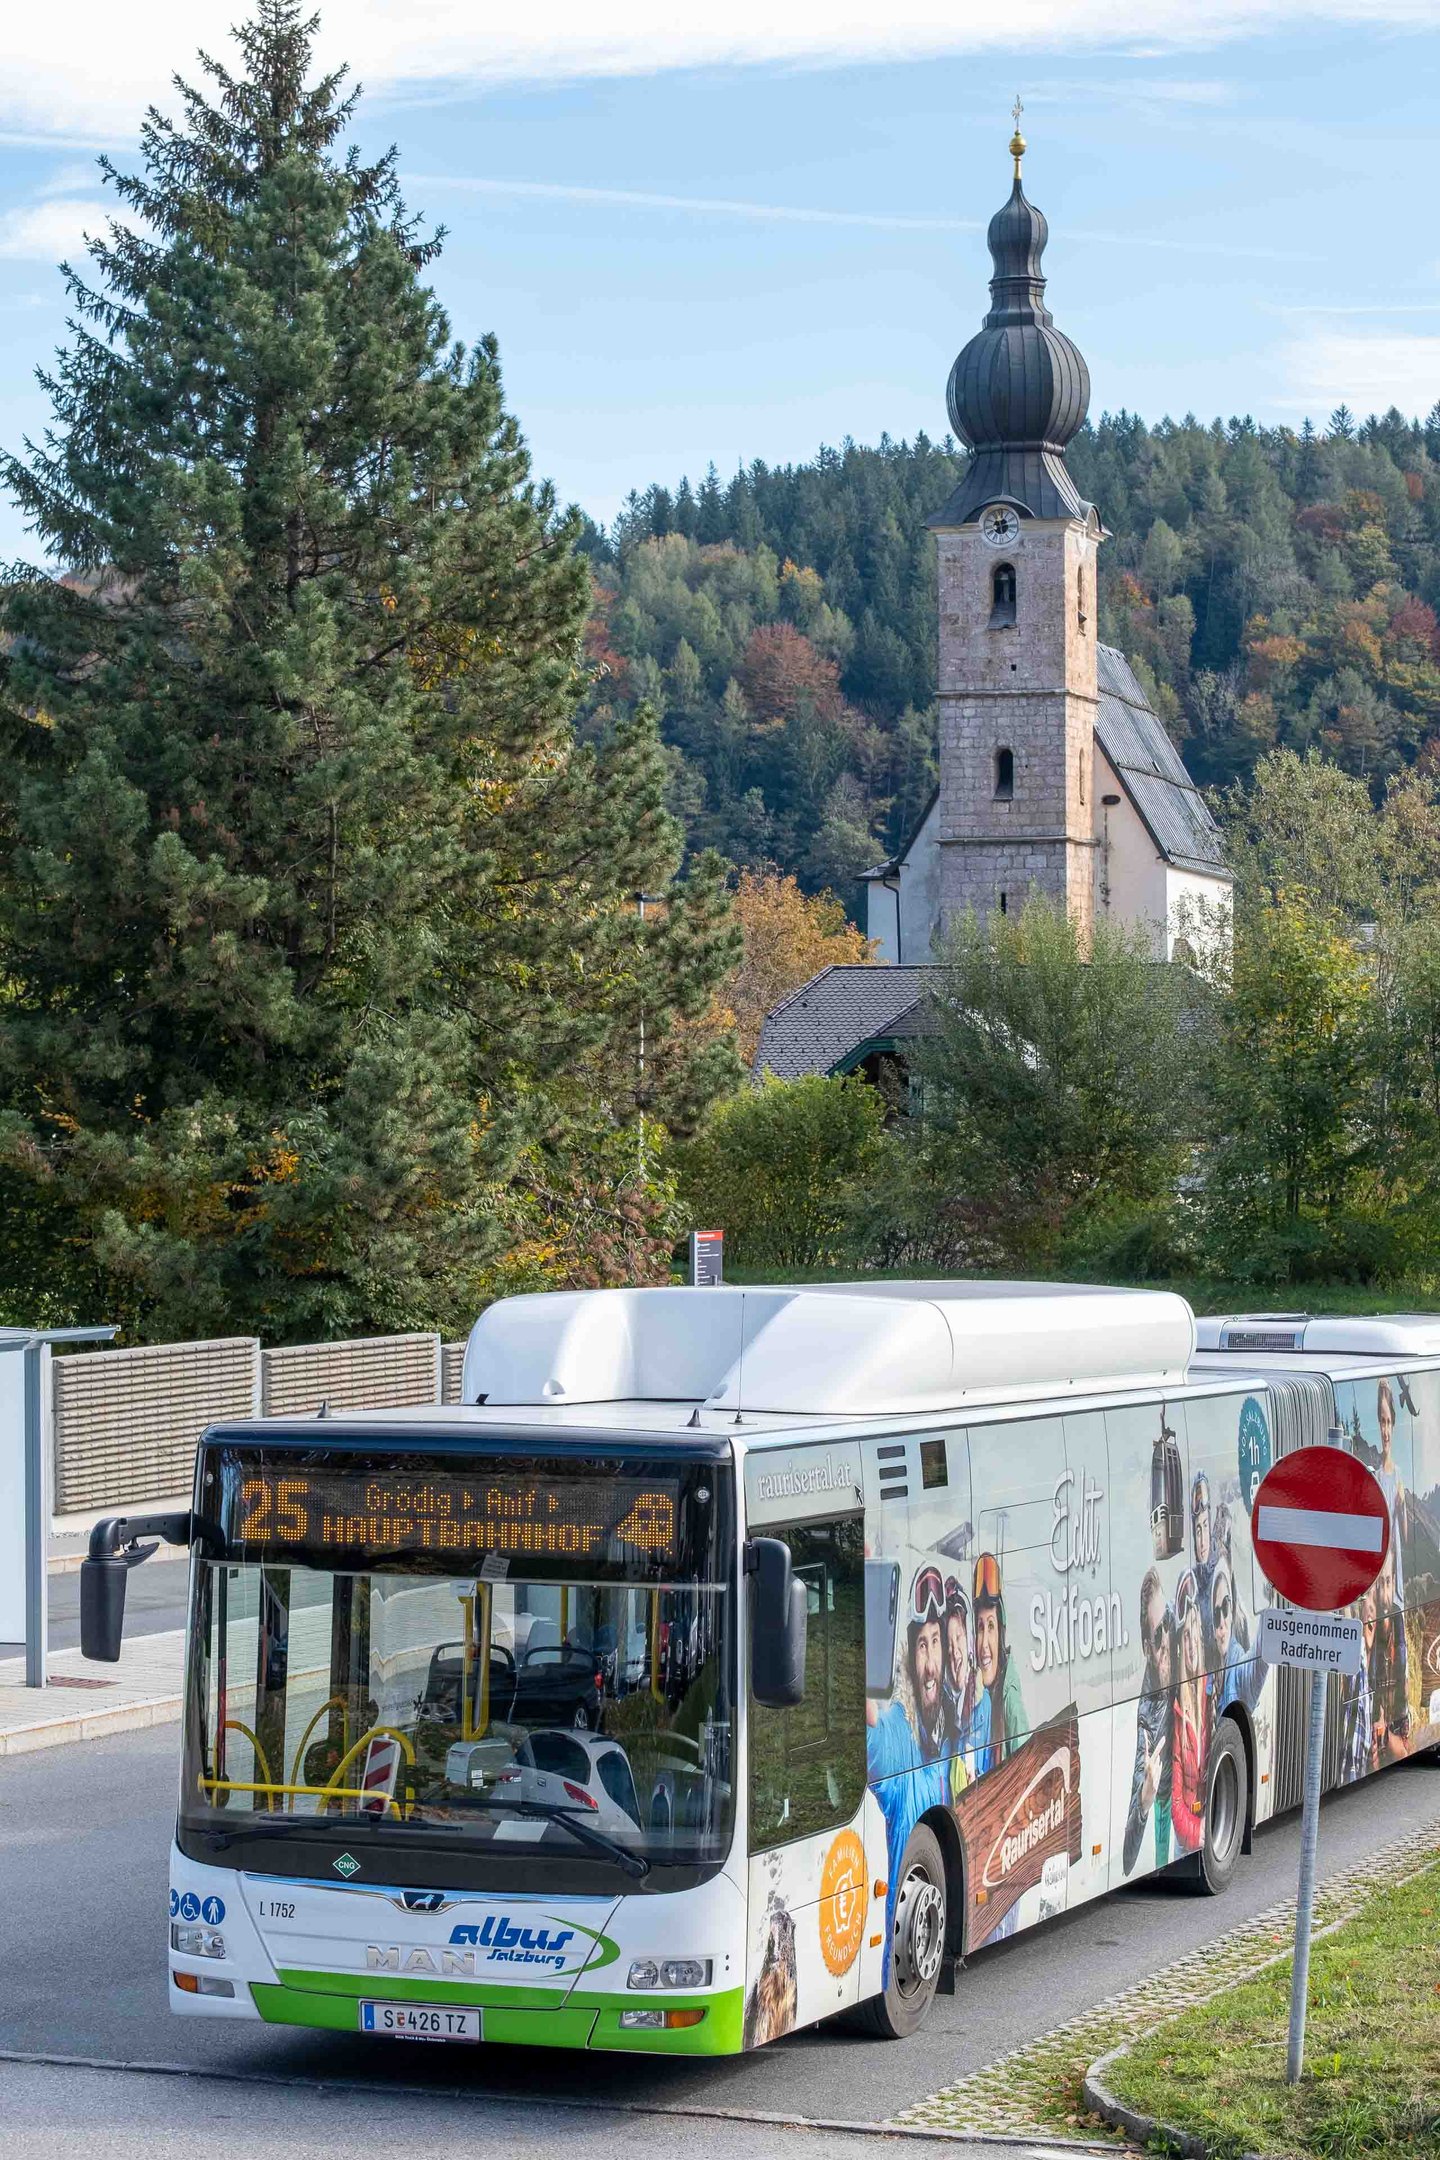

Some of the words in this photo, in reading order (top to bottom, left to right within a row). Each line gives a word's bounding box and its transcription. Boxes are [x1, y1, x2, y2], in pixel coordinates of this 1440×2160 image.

[1248, 1435, 1260, 1466] 1h
[758, 1453, 852, 1500] raurisertal.at
[241, 1480, 308, 1541] 25
[366, 1484, 451, 1517] Grödig
[487, 1488, 536, 1516] Anif
[323, 1515, 604, 1552] HAUPTBAHNHOF
[1030, 1584, 1130, 1672] Skifoan.
[1267, 1618, 1358, 1640] ausgenommen
[1281, 1641, 1342, 1663] Radfahrer
[1001, 1787, 1065, 1875] Raurisertal
[338, 1861, 355, 1870] CNG
[260, 1901, 266, 1916] L
[270, 1902, 296, 1919] 1752
[448, 1916, 575, 1951] albus
[366, 1945, 475, 1976] MAN
[486, 1949, 566, 1970] Salzburg
[408, 2011, 440, 2032] 426
[445, 2014, 466, 2034] TZ
